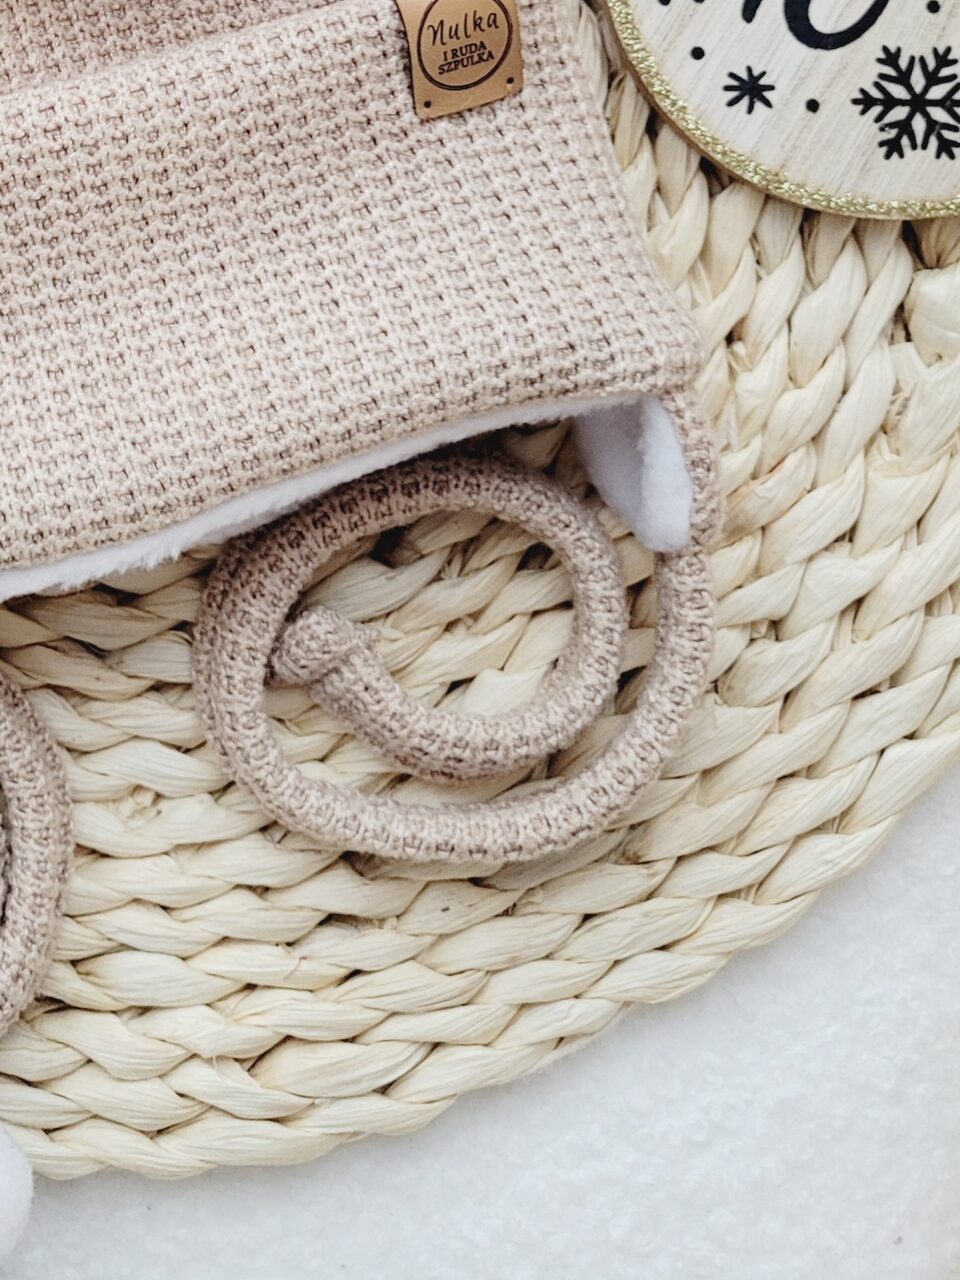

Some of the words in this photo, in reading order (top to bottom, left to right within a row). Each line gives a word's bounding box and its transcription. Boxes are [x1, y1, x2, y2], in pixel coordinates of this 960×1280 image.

[438, 50, 495, 75] SZPULKA
[443, 51, 448, 62] I
[450, 40, 487, 59] RUDA
